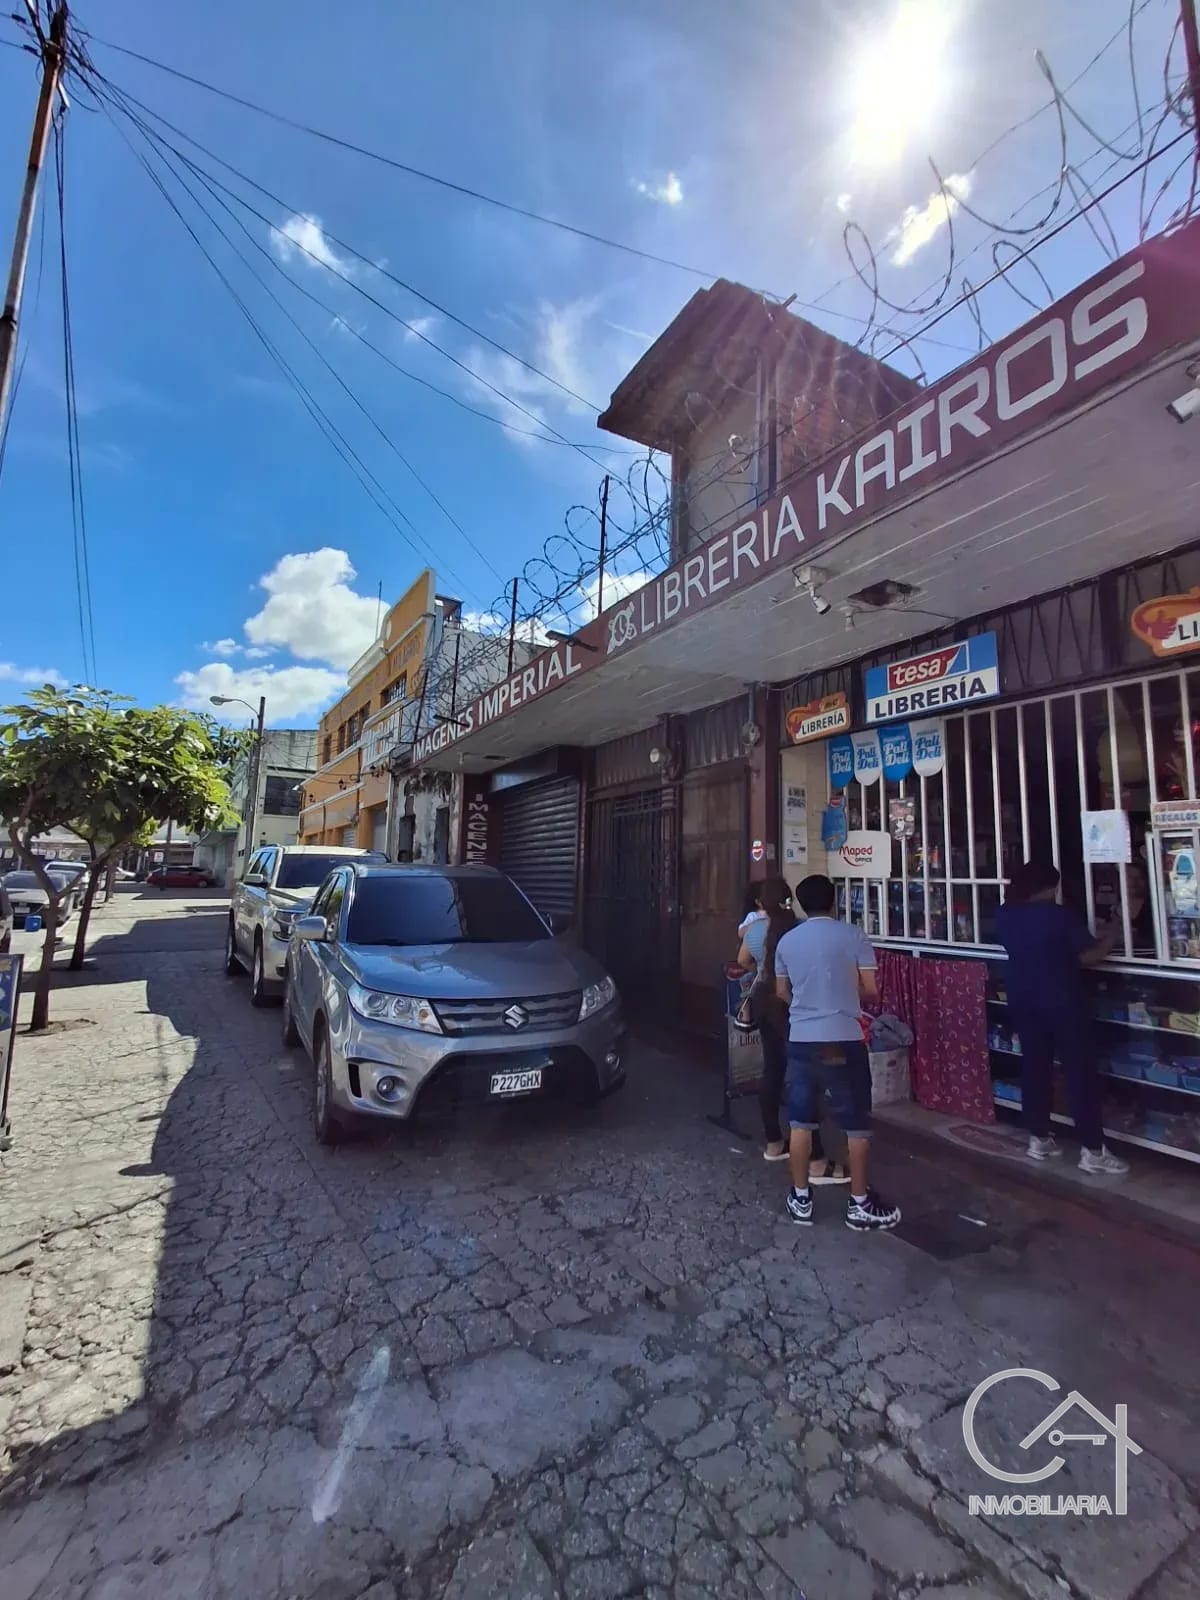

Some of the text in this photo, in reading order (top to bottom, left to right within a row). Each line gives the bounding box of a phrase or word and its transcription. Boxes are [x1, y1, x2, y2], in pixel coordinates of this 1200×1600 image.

[640, 260, 1149, 633] LIBRERIA KAIROS
[412, 706, 474, 764] IMAGENES
[478, 645, 581, 725] IMPERIAL
[875, 677, 986, 718] LIBRERÍA
[893, 658, 941, 686] tesa
